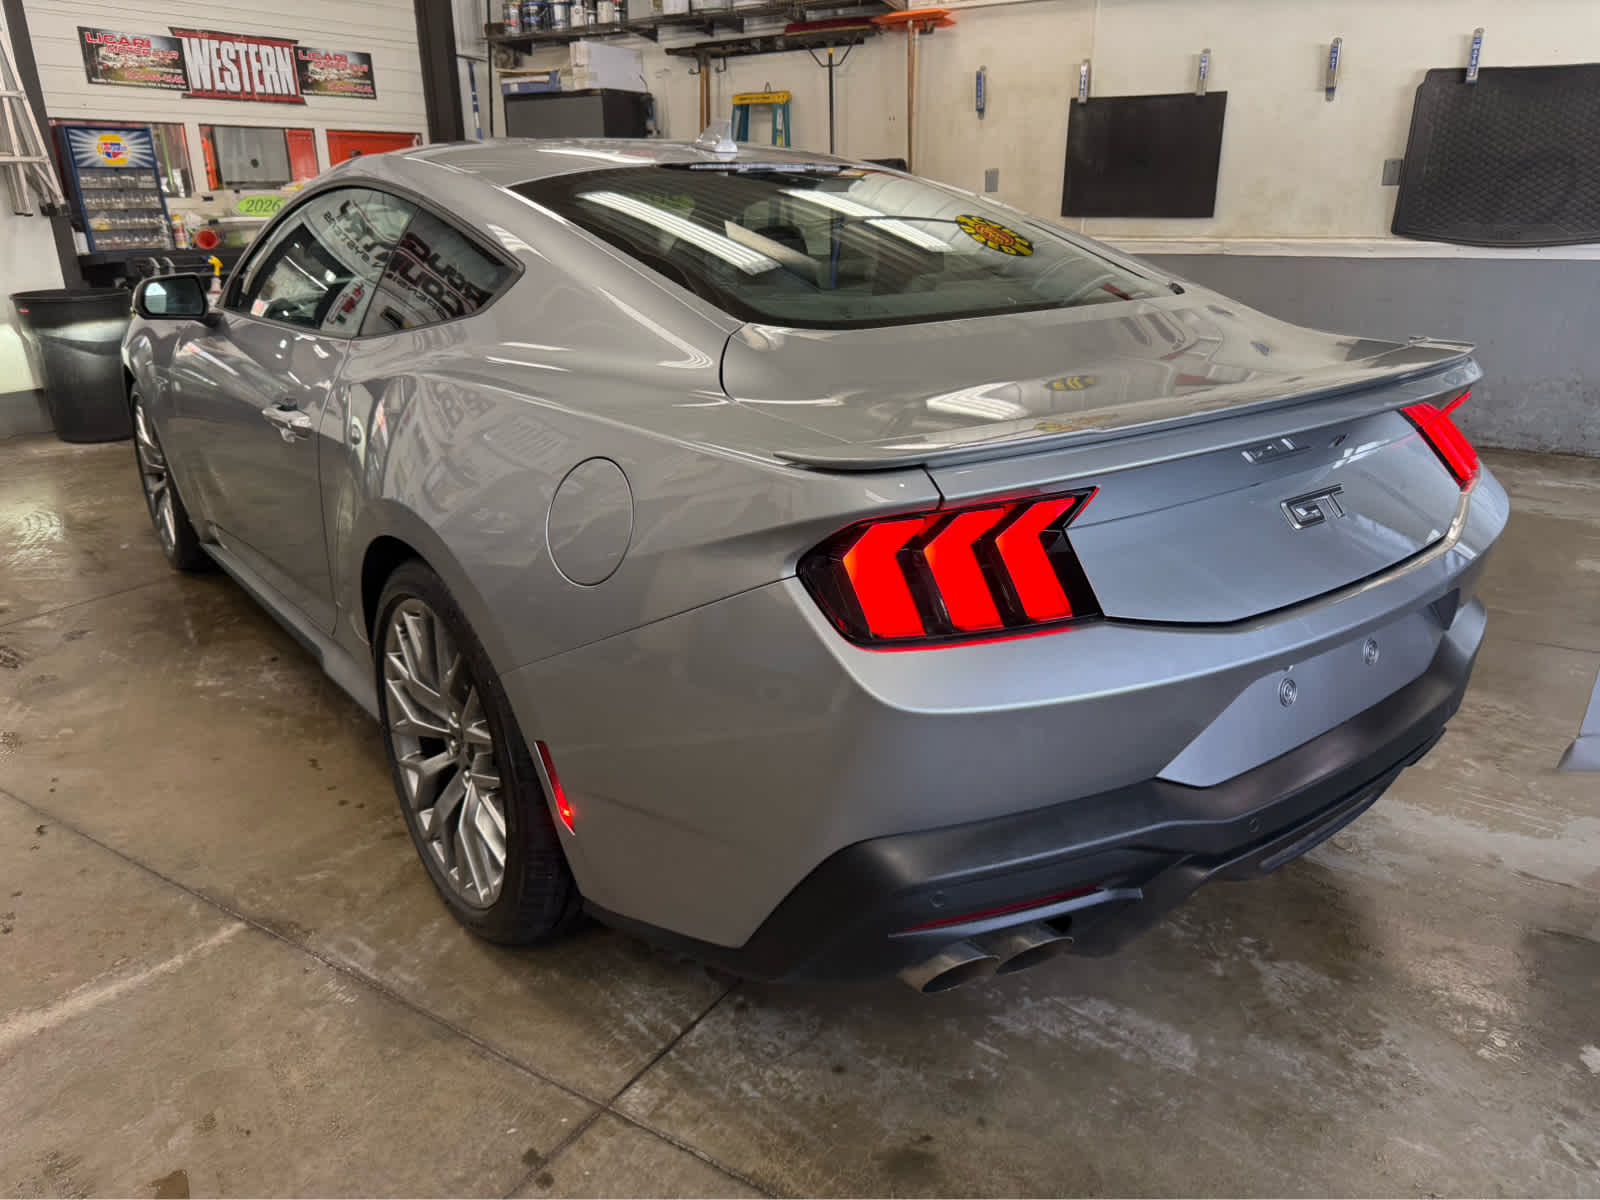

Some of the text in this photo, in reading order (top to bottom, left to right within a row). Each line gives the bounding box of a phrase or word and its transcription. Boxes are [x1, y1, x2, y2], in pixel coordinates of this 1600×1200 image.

[84, 31, 151, 49] LICARI
[181, 37, 297, 96] WESTERN
[246, 198, 282, 213] 2026
[1280, 483, 1345, 530] GT
